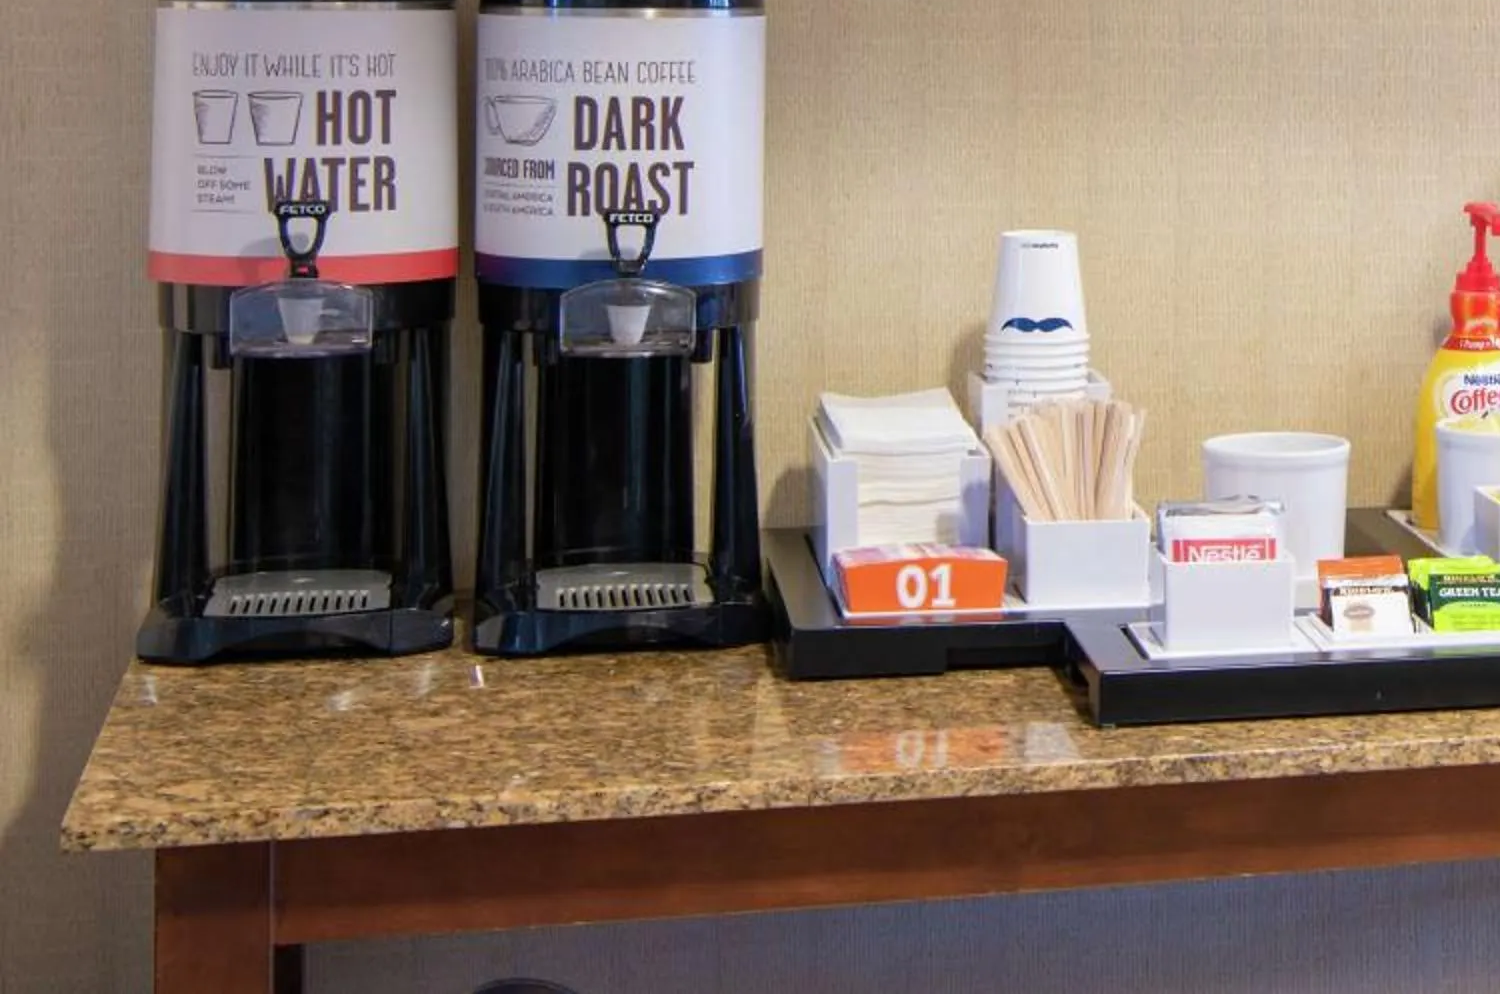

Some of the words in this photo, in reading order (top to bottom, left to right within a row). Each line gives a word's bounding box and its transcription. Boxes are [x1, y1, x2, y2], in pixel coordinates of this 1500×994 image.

[192, 52, 239, 77] ENJOY
[244, 54, 258, 77] IT
[263, 54, 321, 78] WHILE
[331, 53, 360, 77] IT'S
[367, 54, 397, 77] HOT
[510, 59, 575, 83] ARABICA
[583, 60, 629, 83] BEAN
[637, 60, 697, 84] COFFEE
[316, 89, 397, 146] HOT
[573, 96, 685, 151] DARK
[523, 158, 555, 180] FROM
[264, 156, 397, 213] WATER
[567, 161, 695, 217] ROAST
[279, 205, 326, 215] FETCO
[609, 213, 654, 223] FETCO
[1451, 388, 1500, 414] Coffe
[1188, 542, 1263, 562] Nestlé
[896, 563, 956, 608] 01
[1439, 587, 1479, 598] GREEN
